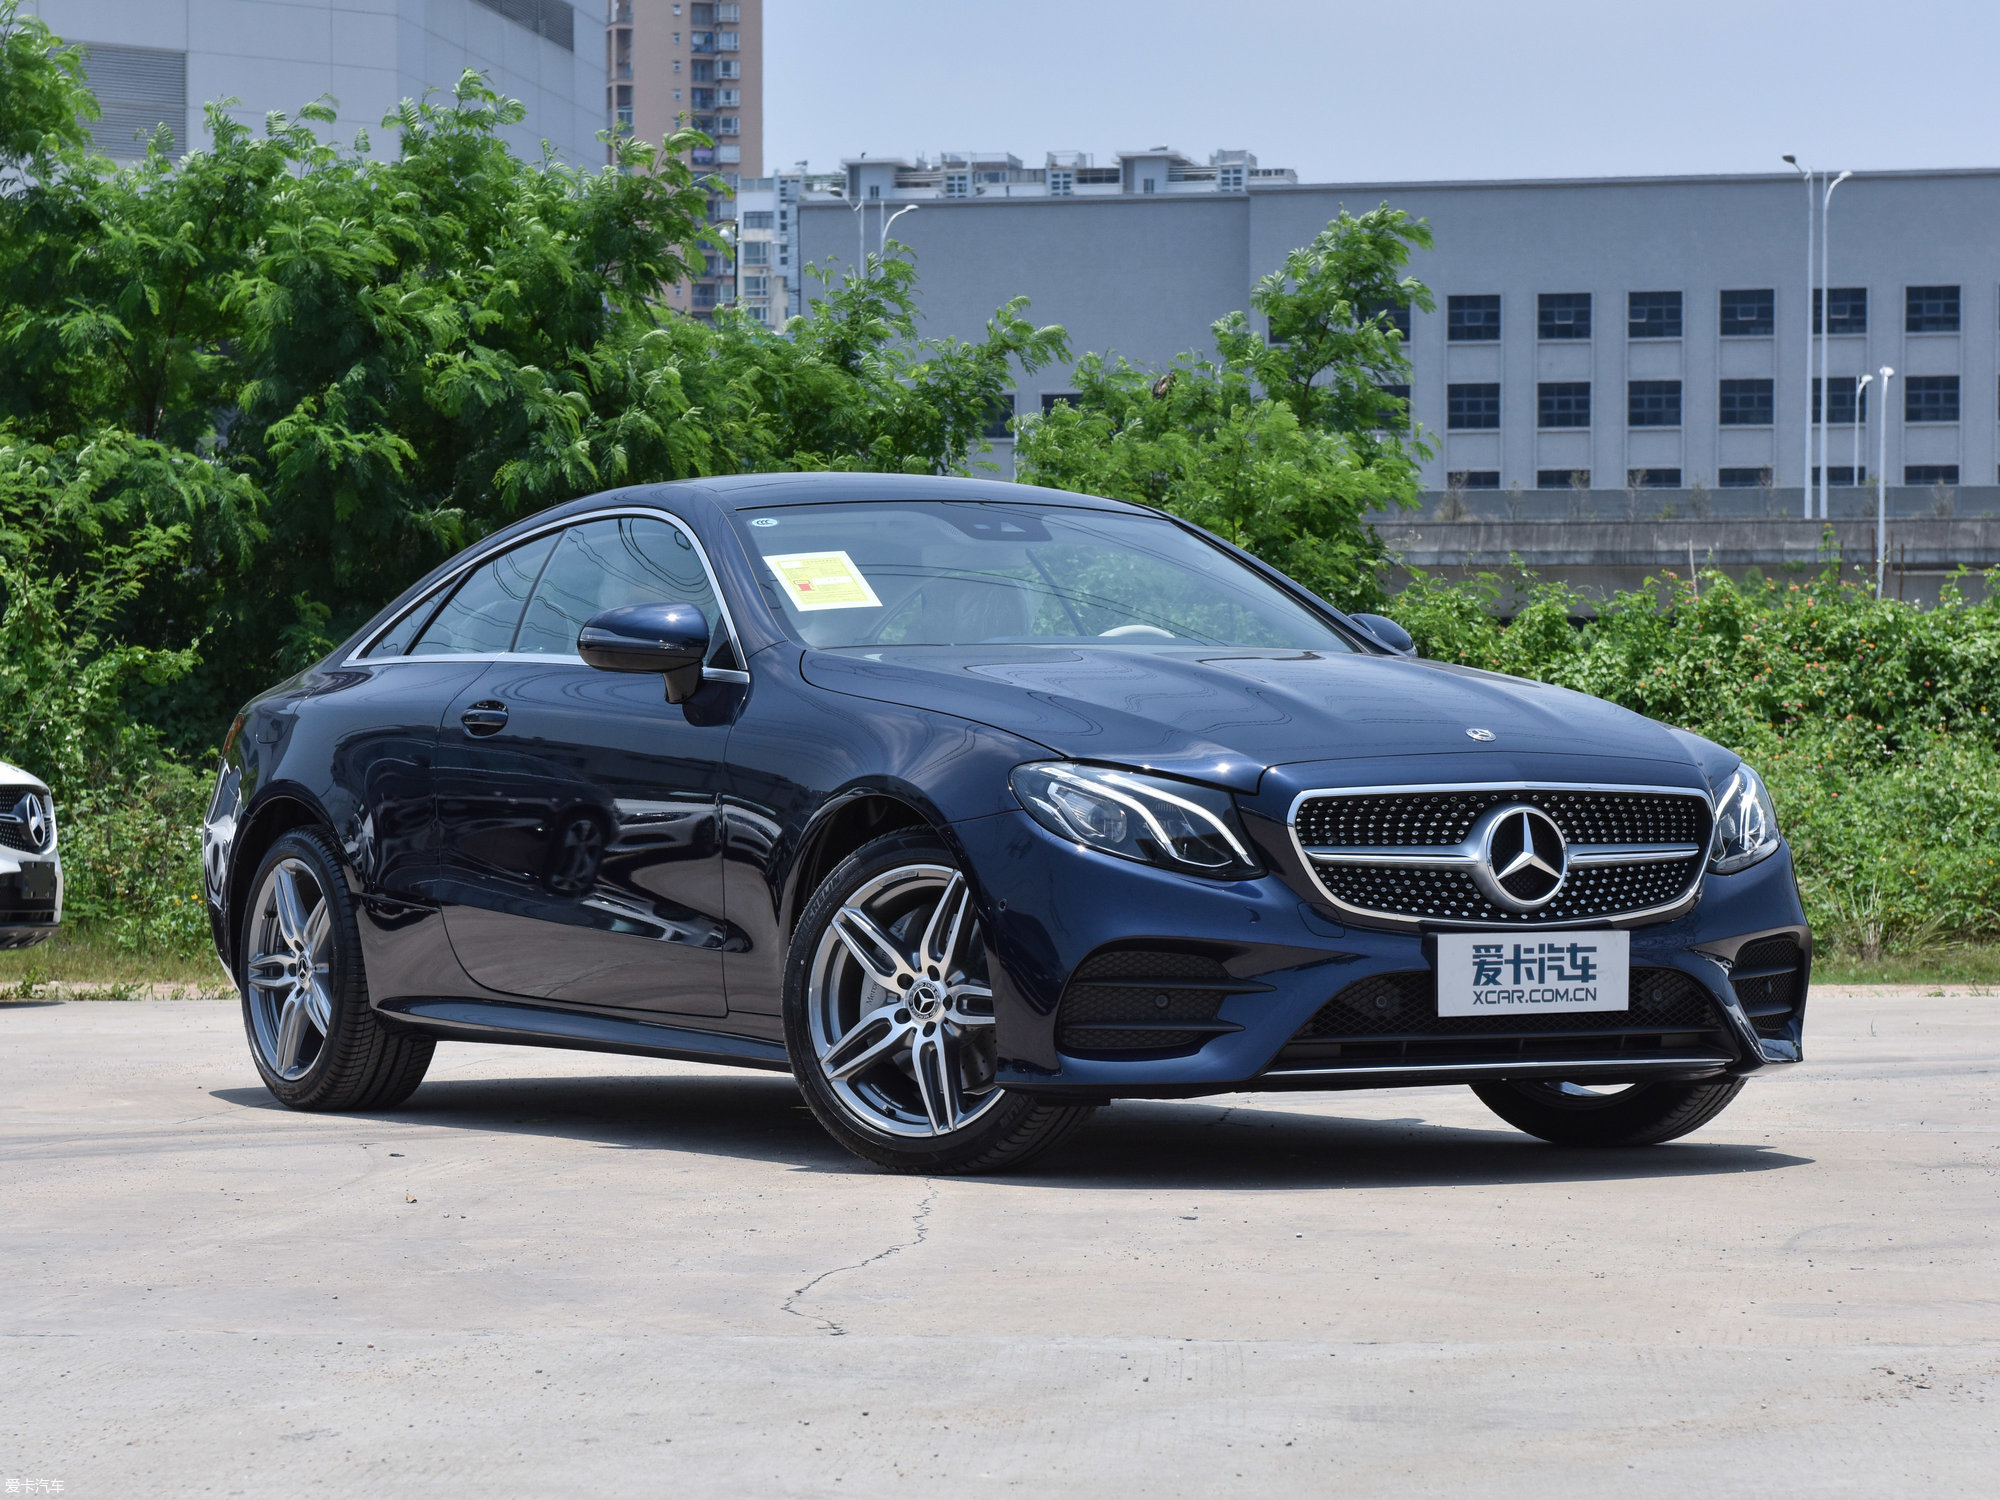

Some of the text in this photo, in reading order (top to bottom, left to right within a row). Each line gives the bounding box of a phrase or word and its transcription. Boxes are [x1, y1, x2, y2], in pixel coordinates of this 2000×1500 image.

[801, 872, 846, 932] ICHELIN
[1472, 943, 1598, 986] 爱卡汽车
[1472, 987, 1597, 1005] XCAR.COM.CN
